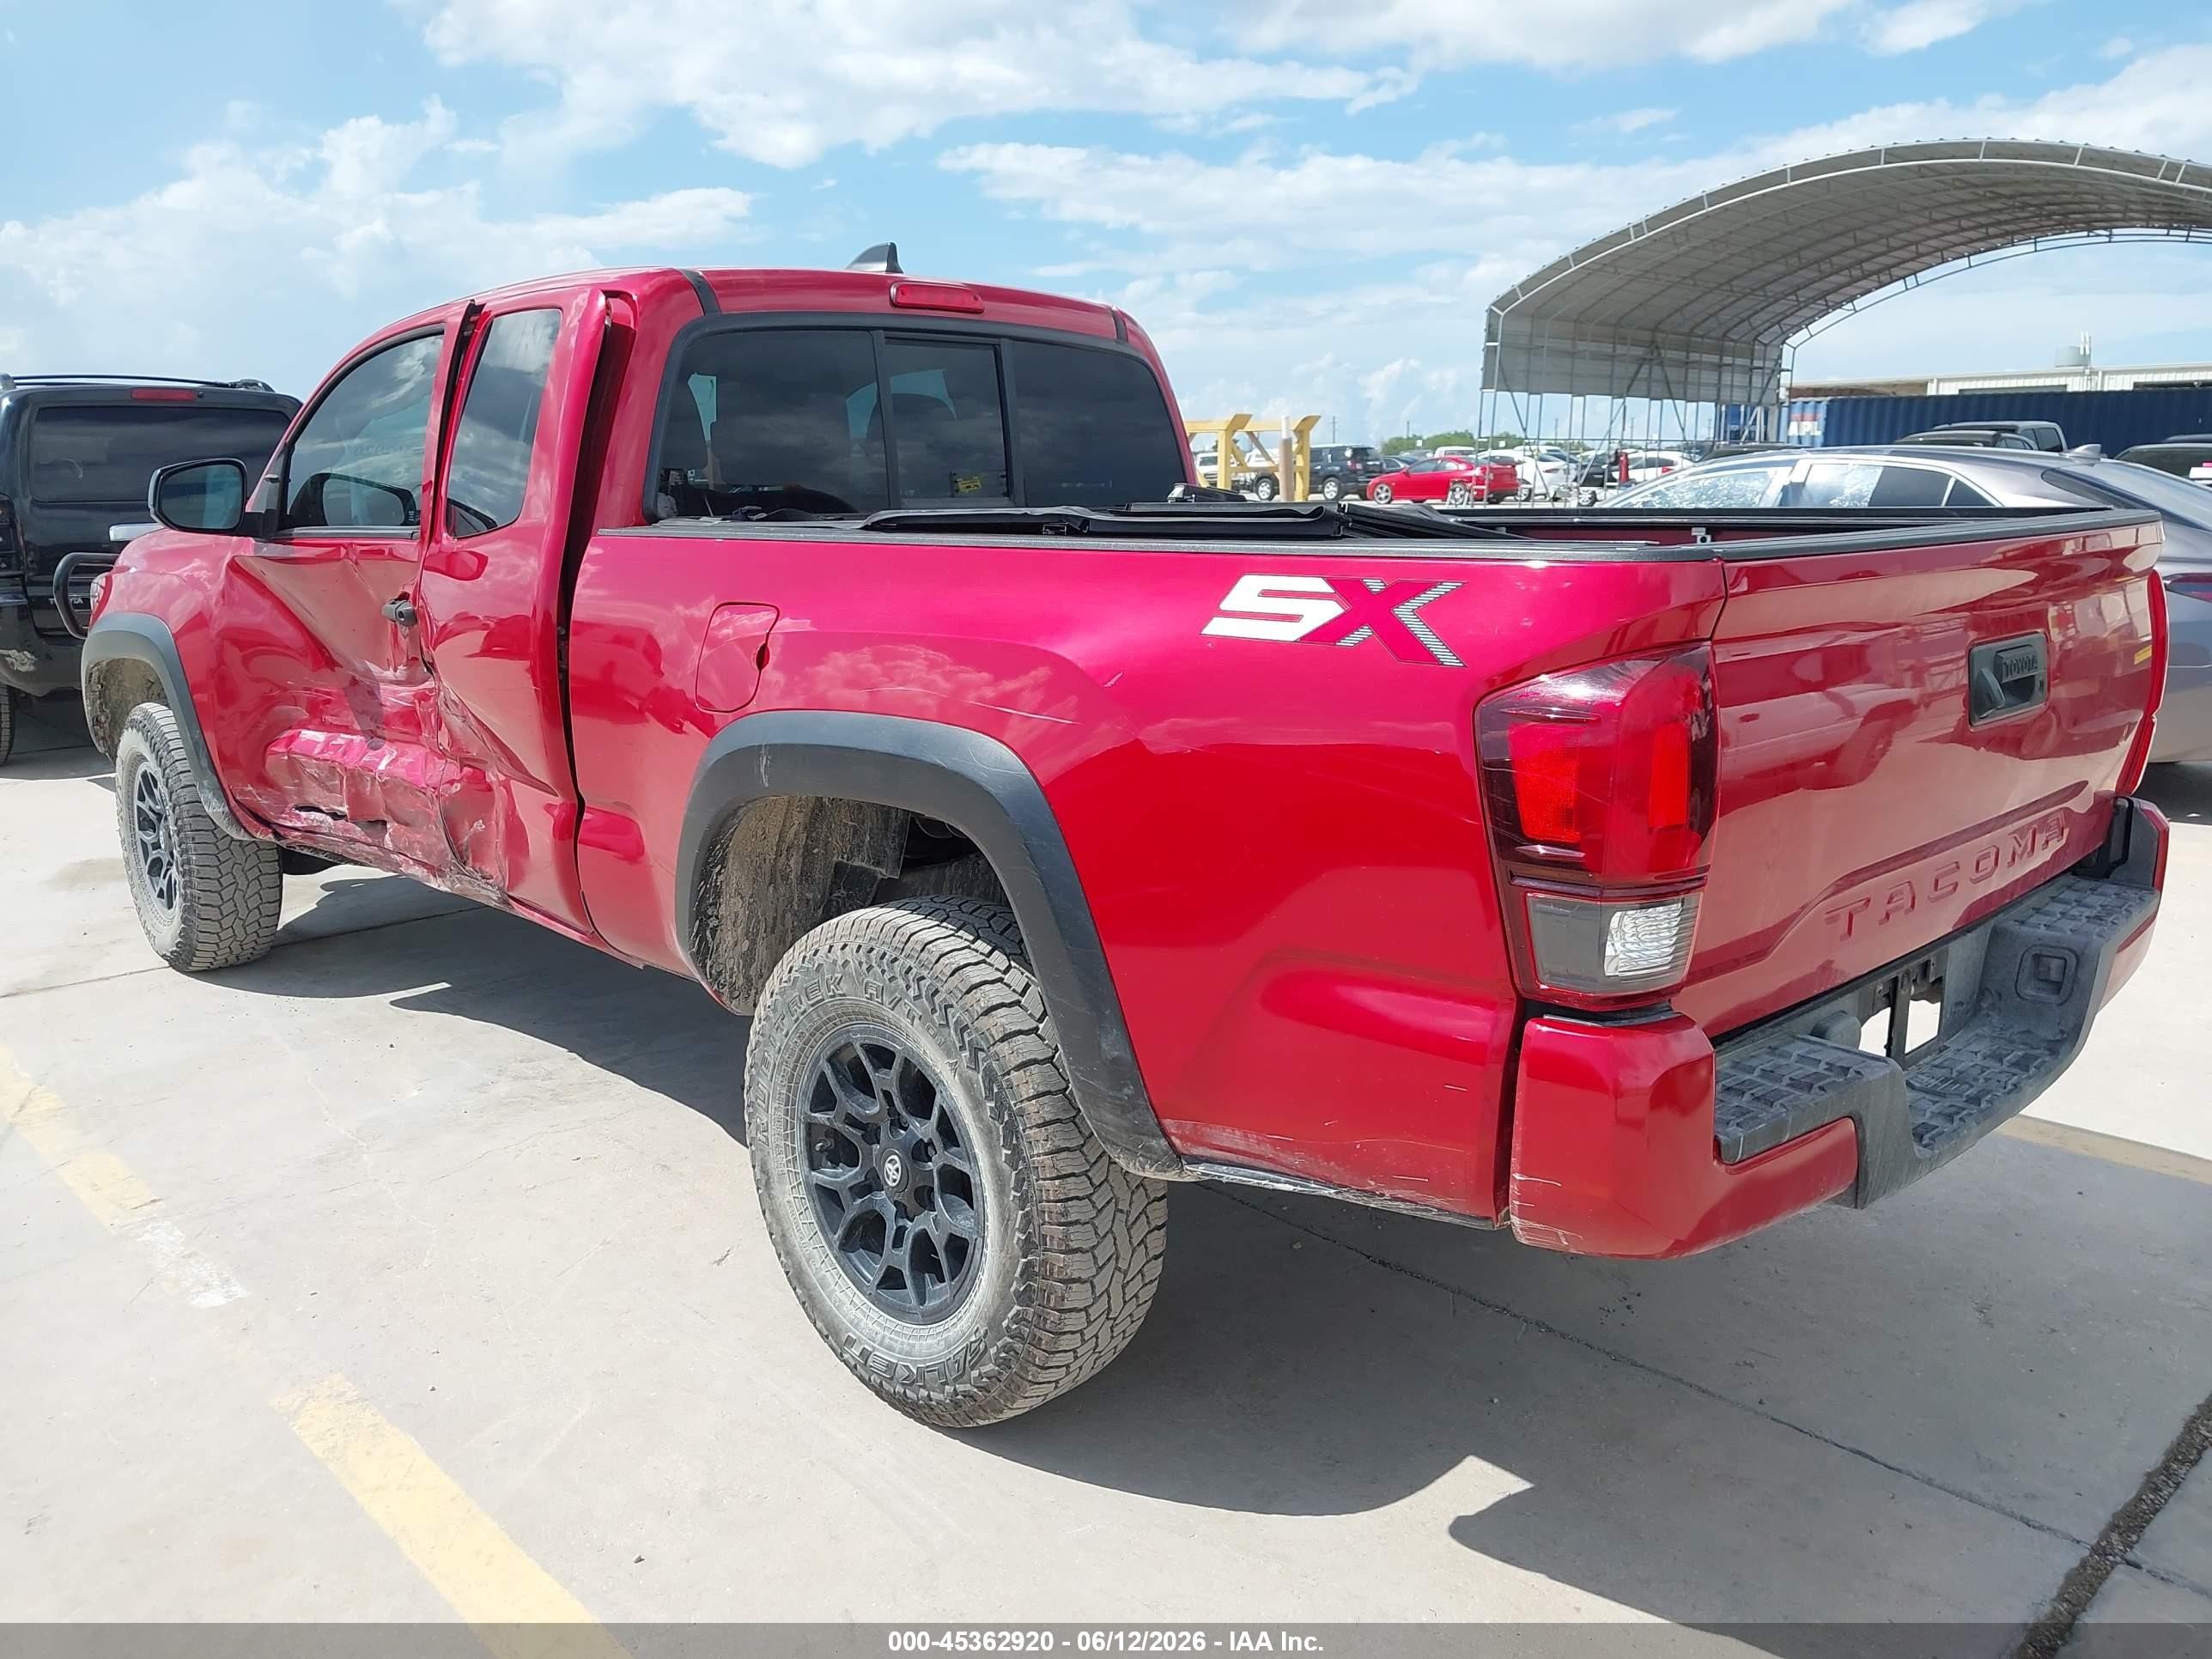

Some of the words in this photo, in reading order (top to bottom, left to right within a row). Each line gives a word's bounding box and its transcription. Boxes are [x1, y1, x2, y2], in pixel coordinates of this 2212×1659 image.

[1788, 421, 1821, 436] APL
[2002, 653, 2039, 678] TOYOTA
[1823, 810, 2069, 942] TACOMA
[843, 1327, 989, 1388] FALKEN
